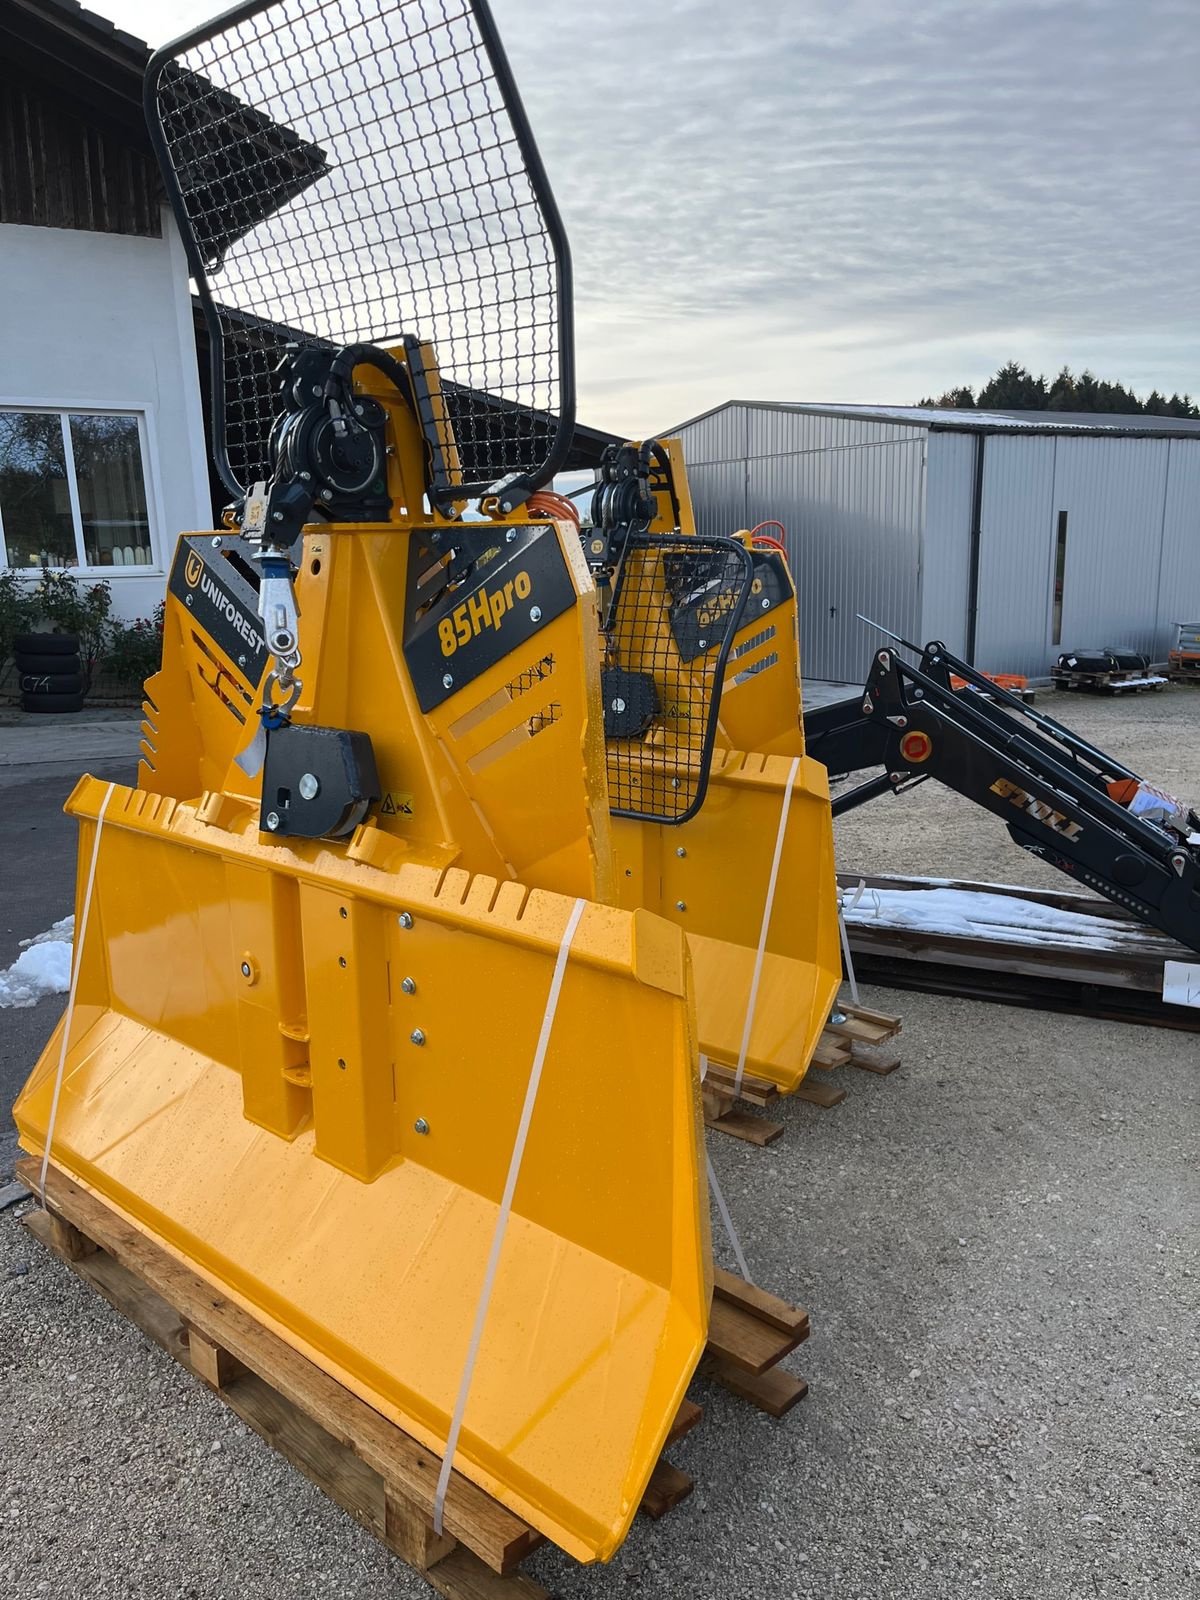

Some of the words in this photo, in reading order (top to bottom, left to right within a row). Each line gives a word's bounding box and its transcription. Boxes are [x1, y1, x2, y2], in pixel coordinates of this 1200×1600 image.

[201, 573, 265, 655] UNIFOREST
[438, 571, 531, 657] 85Hpro
[989, 778, 1084, 843] STOLL
